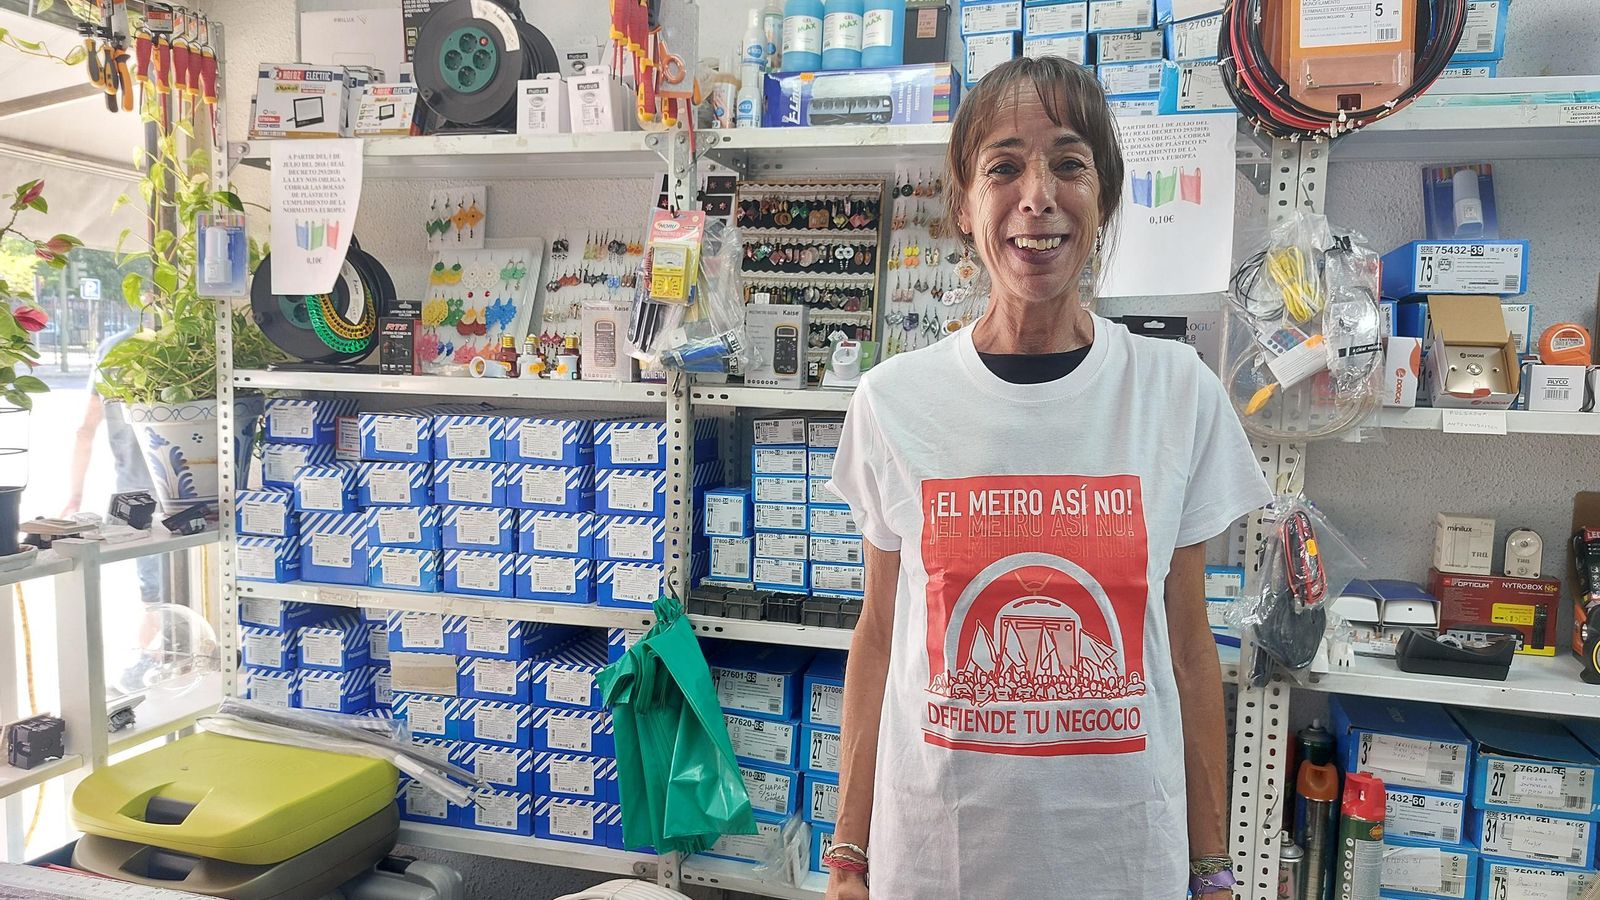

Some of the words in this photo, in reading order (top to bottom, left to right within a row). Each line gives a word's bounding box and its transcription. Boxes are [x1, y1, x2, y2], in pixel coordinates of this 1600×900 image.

[1375, 3, 1384, 16] 5
[797, 23, 816, 32] MAX
[839, 20, 859, 30] MAX
[865, 15, 882, 29] MAX
[1177, 34, 1188, 58] 27
[1182, 69, 1193, 97] 27
[1127, 148, 1176, 156] CUMPLIMIENTO
[1150, 215, 1175, 224] 0,10€
[1435, 245, 1484, 256] 75432-39
[1420, 257, 1433, 282] 75
[930, 492, 961, 526] ¡EL
[969, 489, 1043, 516] METRO
[1051, 484, 1088, 516] ASÍ
[1095, 488, 1133, 516] NO!
[1447, 524, 1473, 533] minilux
[1502, 582, 1543, 590] NYTROBOX
[722, 670, 757, 683] 27601-65
[812, 692, 822, 712] 27
[730, 717, 765, 731] 27620-65
[928, 702, 1017, 735] DEFIENDE
[1024, 710, 1049, 734] TU
[1056, 706, 1141, 733] NEGOCIO
[812, 739, 822, 760] 27
[1492, 772, 1506, 796] 27
[814, 791, 824, 812] 27
[1485, 819, 1498, 843] 31
[1494, 877, 1507, 900] 75
